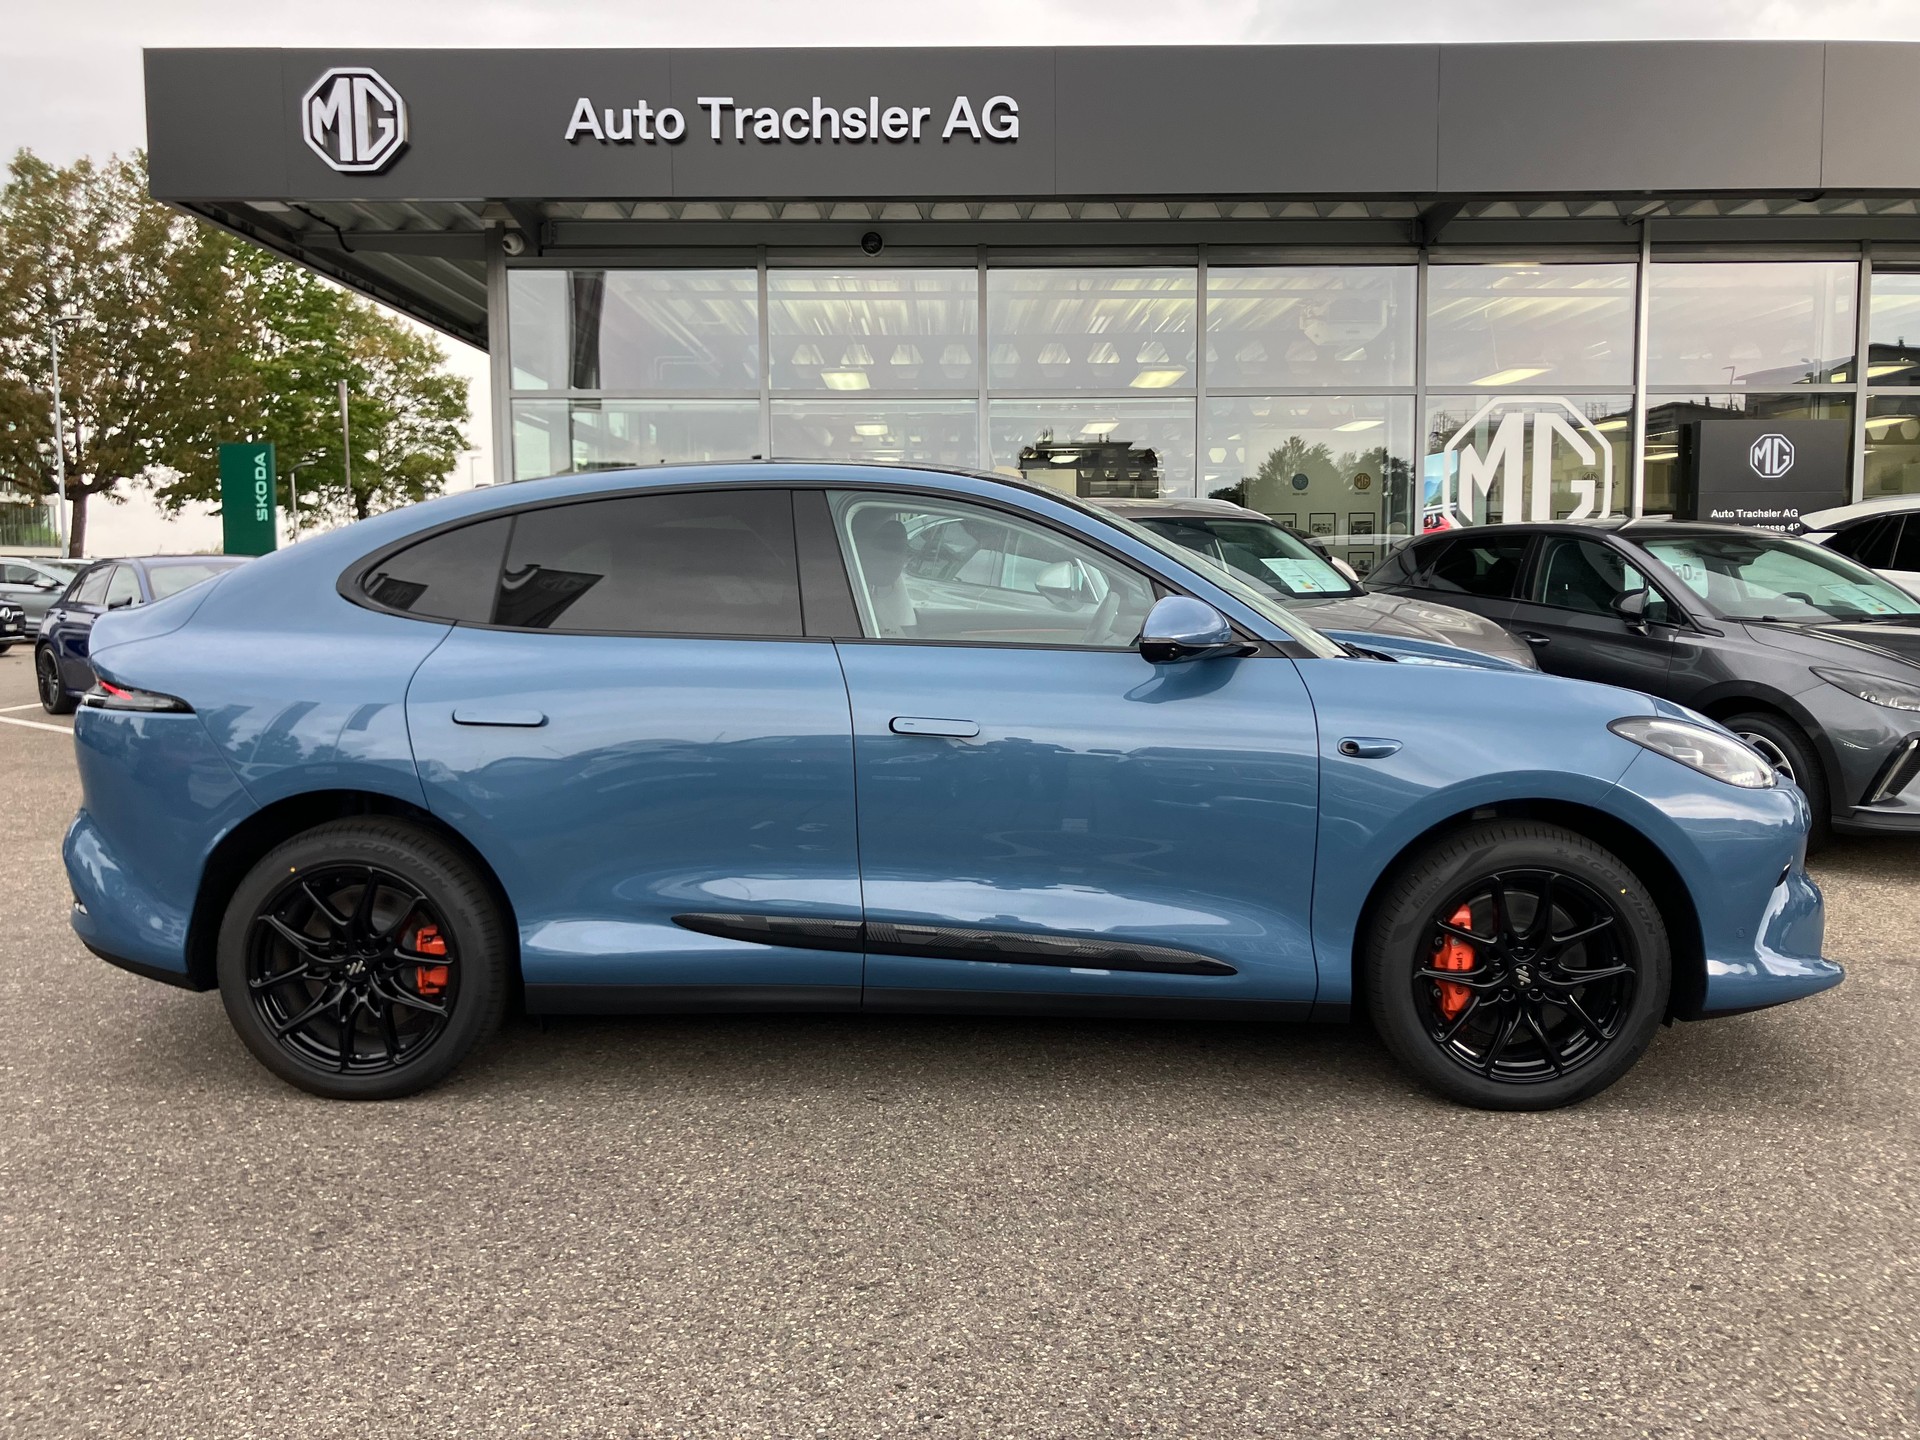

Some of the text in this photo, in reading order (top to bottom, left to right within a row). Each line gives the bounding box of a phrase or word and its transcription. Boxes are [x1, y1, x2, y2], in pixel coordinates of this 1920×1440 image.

[310, 76, 396, 162] MG
[564, 94, 1020, 141] Auto Trachsler AG
[1458, 412, 1596, 524] MG
[1753, 437, 1791, 475] MG
[1710, 508, 1799, 518] Auto Trachsler AG
[1575, 854, 1657, 935] SCORPION
